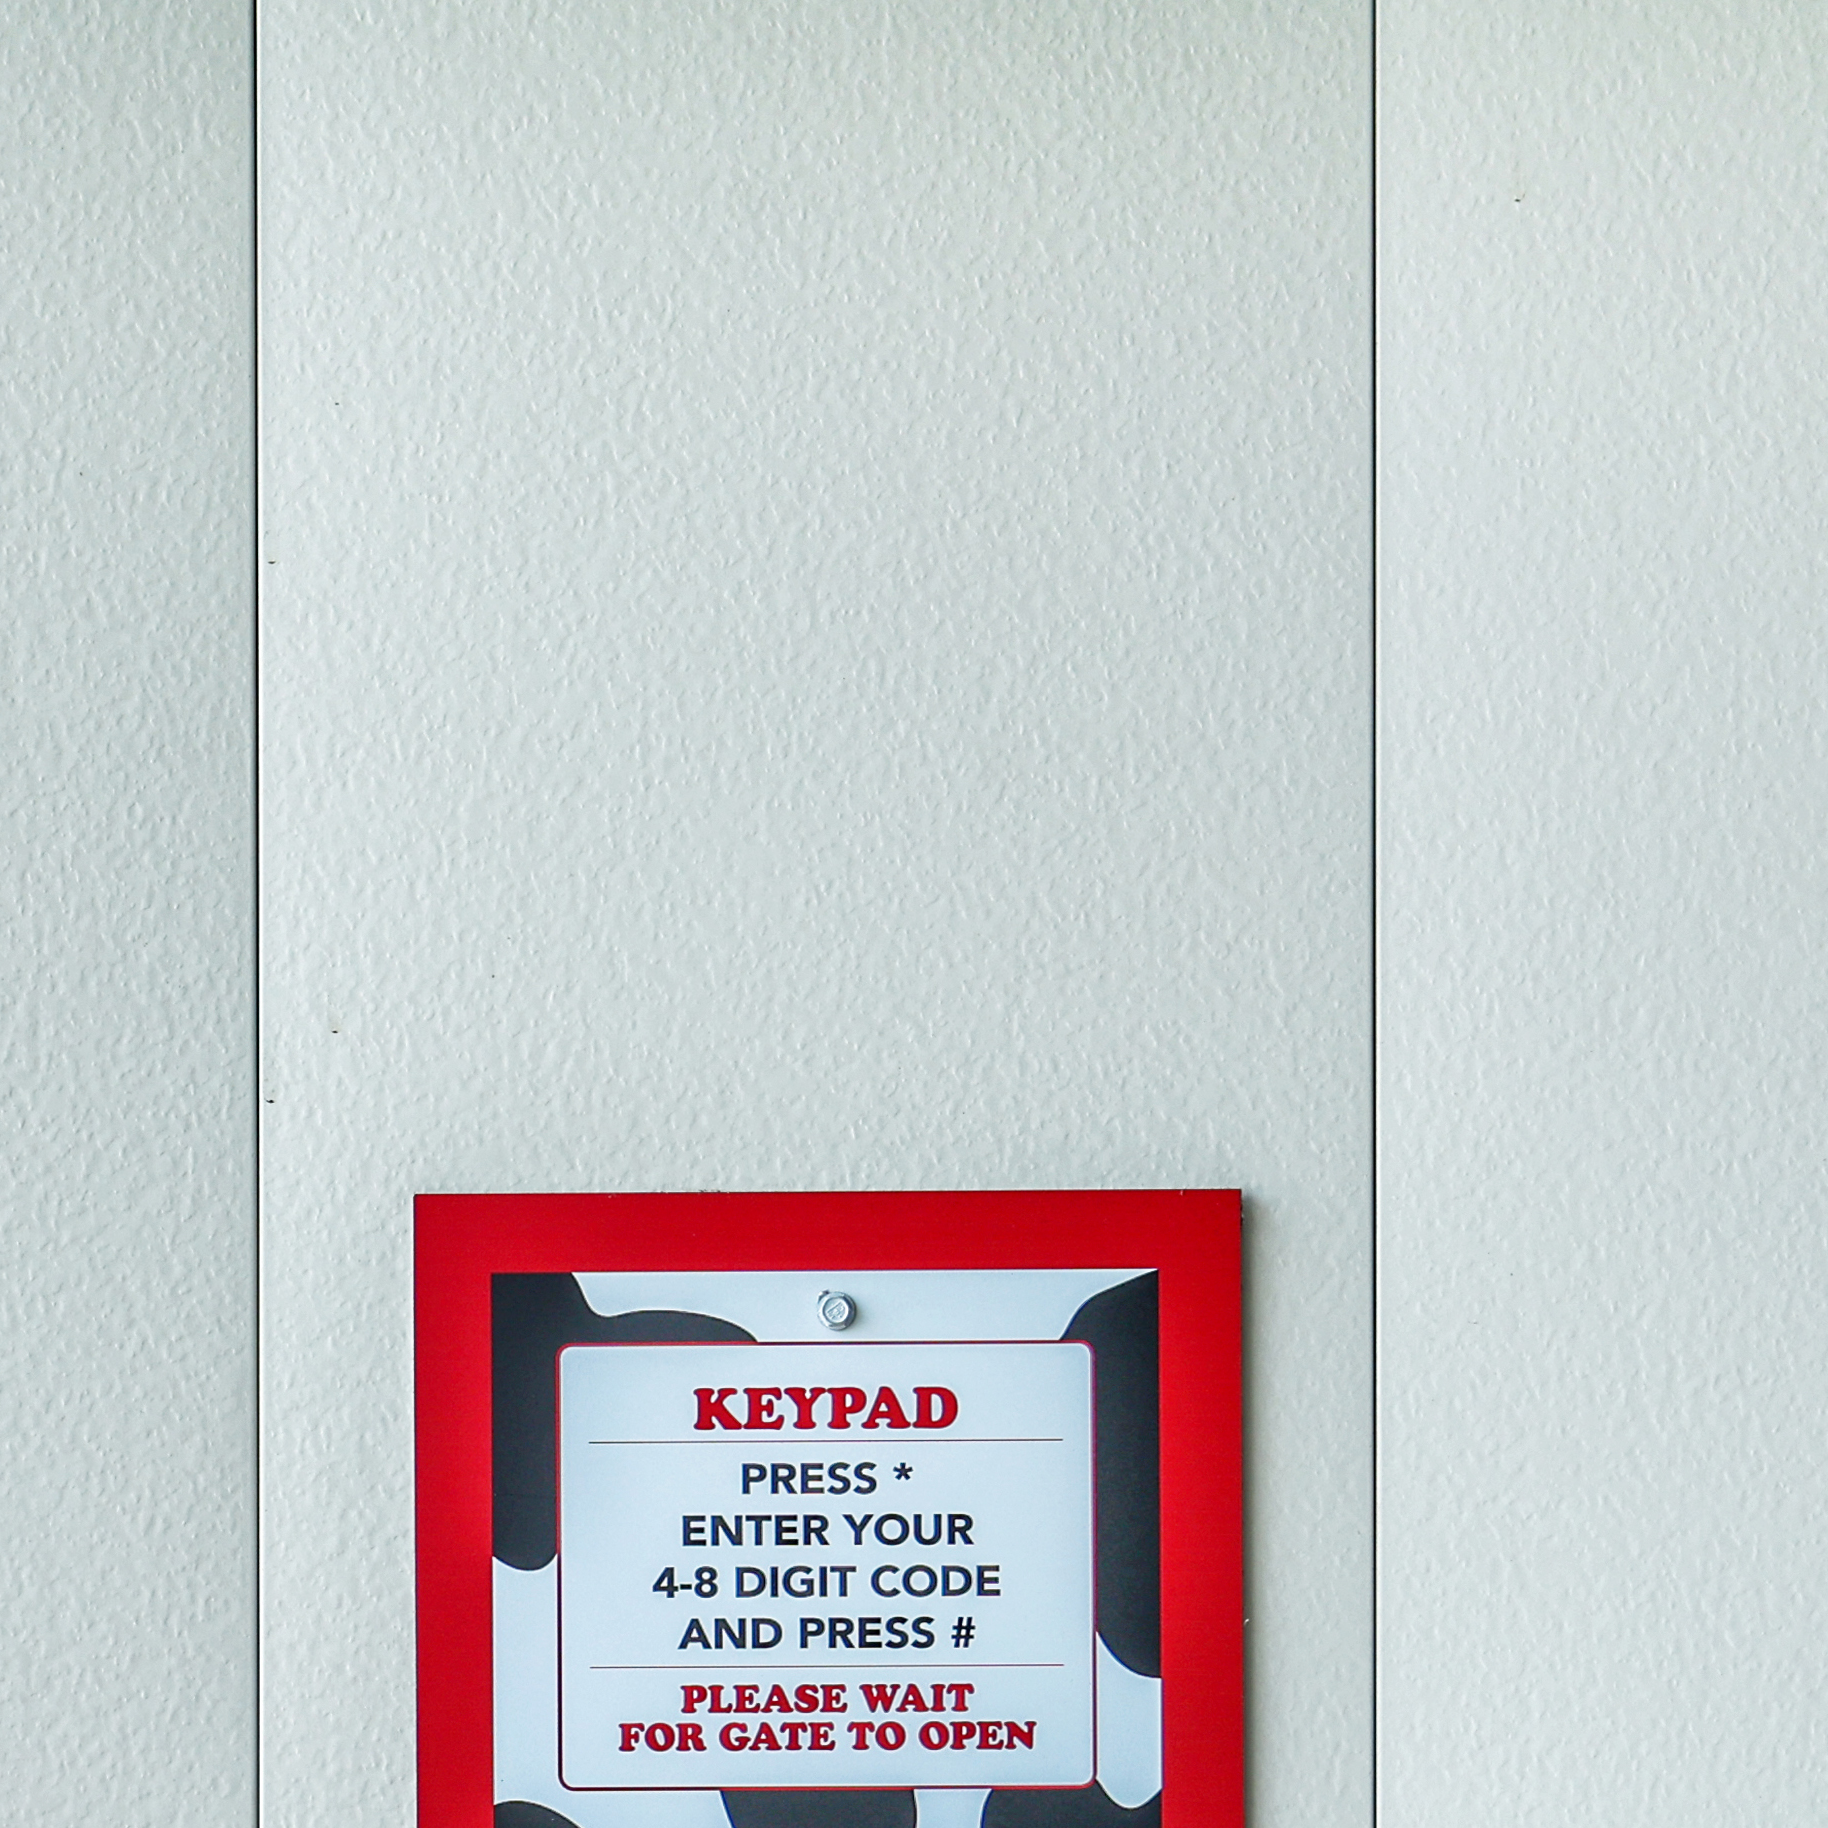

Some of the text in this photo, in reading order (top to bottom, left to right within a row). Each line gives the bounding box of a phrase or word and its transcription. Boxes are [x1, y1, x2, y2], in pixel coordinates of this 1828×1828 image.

[693, 1386, 959, 1431] KEYPAD
[741, 1461, 877, 1495] PRESS
[682, 1513, 974, 1547] ENTER YOUR
[652, 1564, 1001, 1599] 4-8 DIGIT CODE
[677, 1616, 976, 1650] AND PRESS #
[680, 1683, 975, 1714] PLEASE WAIT
[618, 1720, 1037, 1752] FOR GATE TO OPEN
